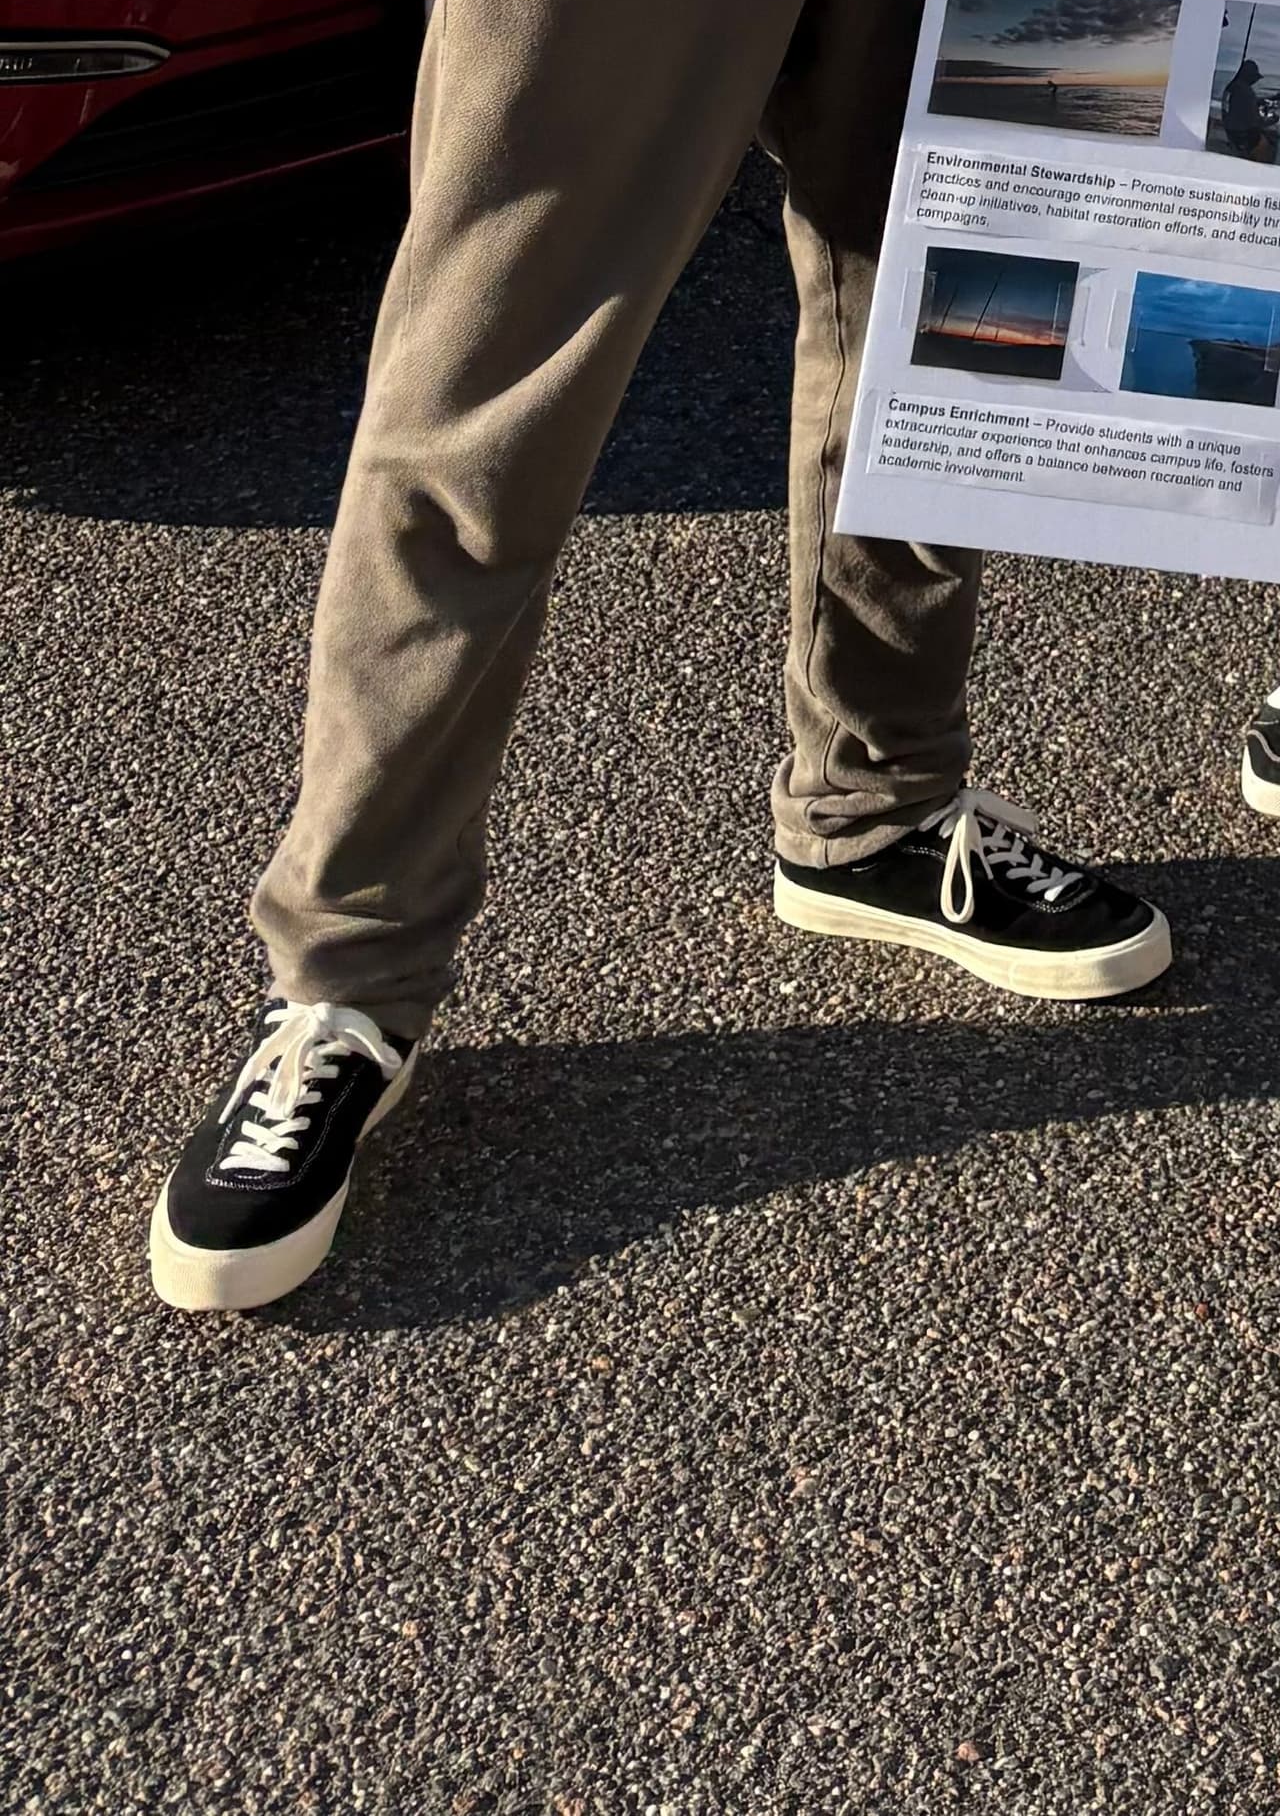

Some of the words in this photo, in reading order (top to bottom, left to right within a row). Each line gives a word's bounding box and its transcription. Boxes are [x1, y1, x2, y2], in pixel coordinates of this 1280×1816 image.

[926, 151, 1027, 177] Environmental
[1030, 164, 1116, 190] Stewardship
[1131, 178, 1185, 198] Promote
[1188, 189, 1260, 208] sustainable
[888, 397, 946, 418] Campus
[949, 405, 1030, 428] Enrichment
[1045, 418, 1095, 437] Provide
[1098, 427, 1153, 445] students
[1156, 433, 1182, 448] with
[1185, 439, 1194, 450] a
[1197, 440, 1241, 456] unique
